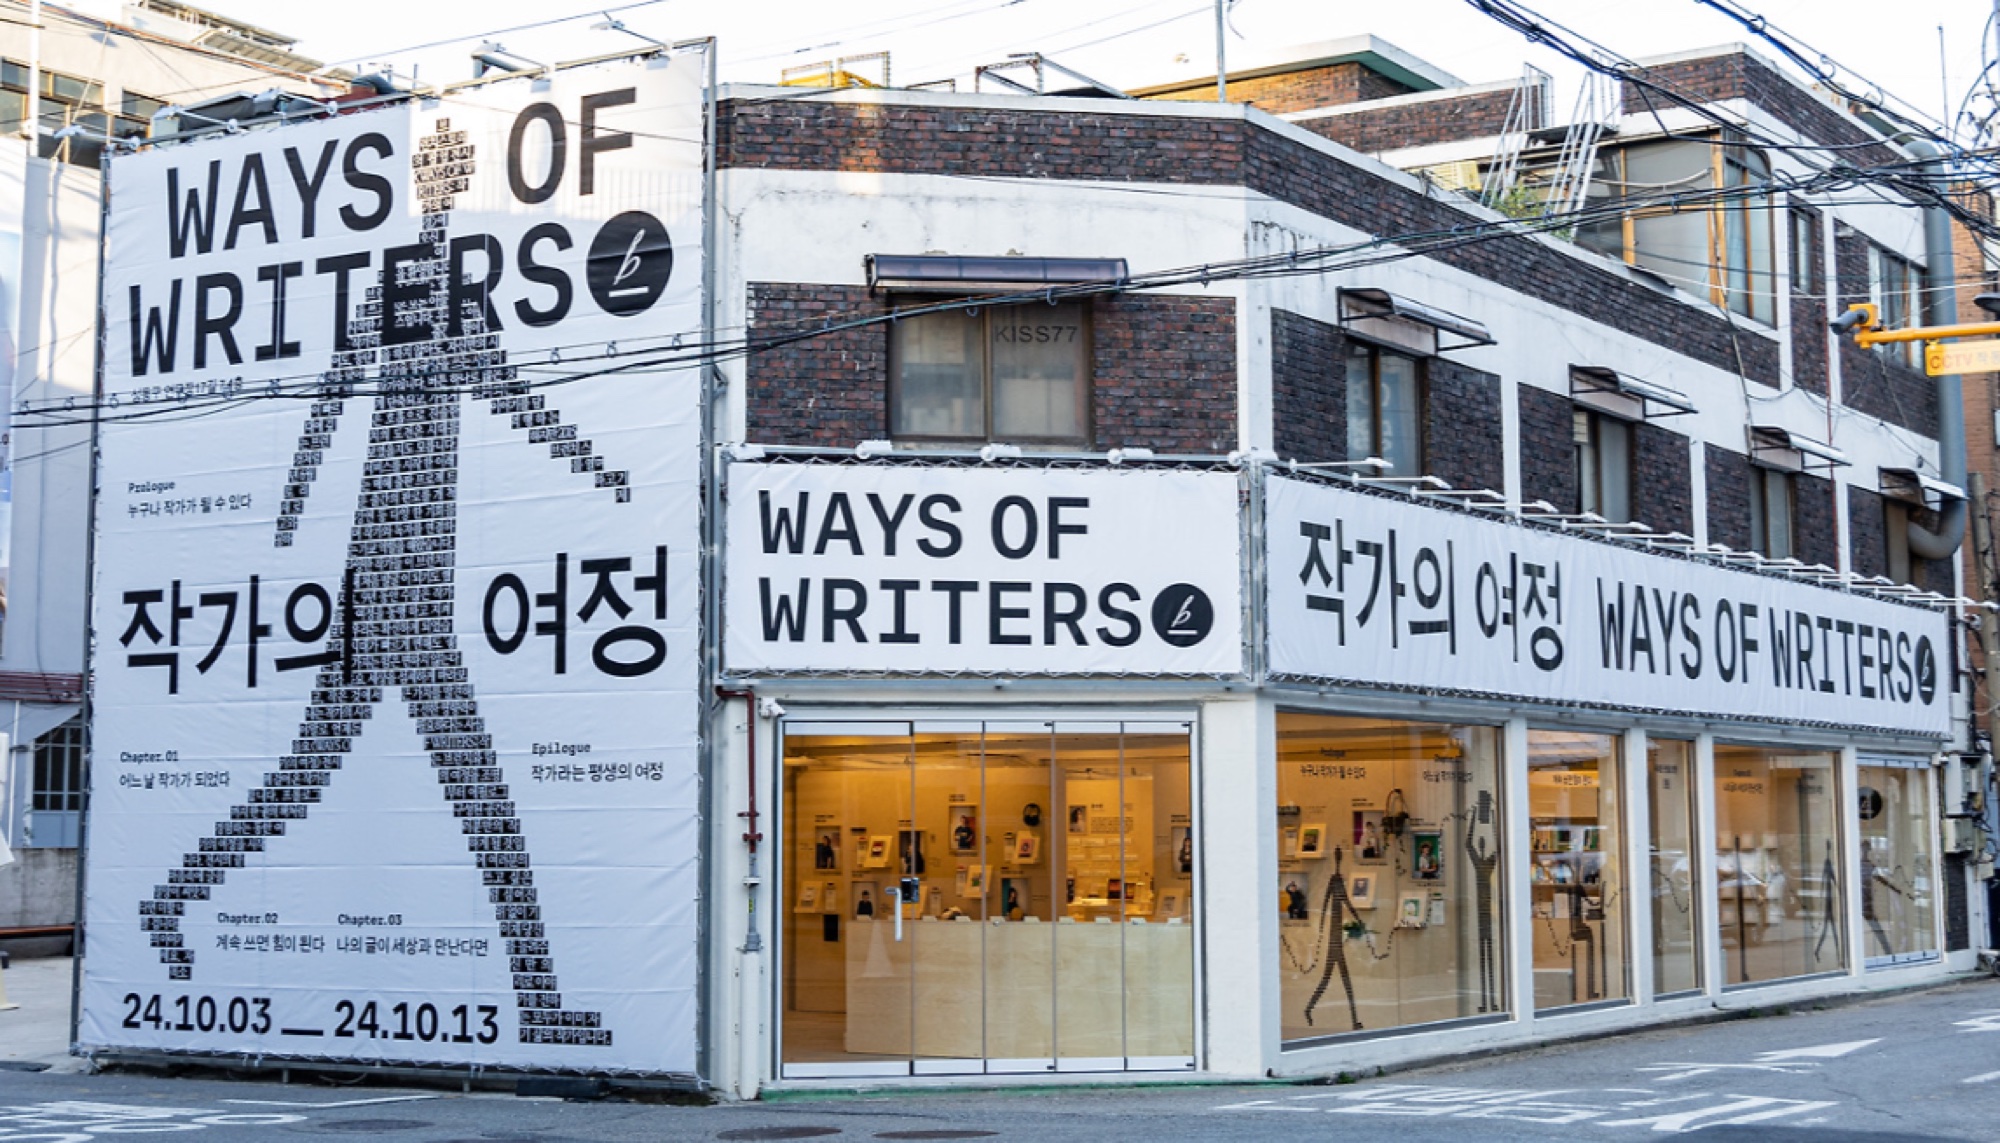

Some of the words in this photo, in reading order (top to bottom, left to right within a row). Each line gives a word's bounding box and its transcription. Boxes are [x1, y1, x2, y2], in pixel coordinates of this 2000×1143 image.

[167, 131, 394, 259] WAYS
[507, 87, 637, 204] OF
[129, 222, 574, 377] WRITERS
[994, 325, 1078, 343] KISS77
[1930, 353, 1972, 370] CCTV
[128, 481, 176, 494] Prologue
[127, 500, 161, 518] 누구나
[163, 497, 197, 515] 작가가
[199, 496, 212, 514] 될
[214, 495, 226, 512] 수
[228, 492, 252, 511] 있다
[758, 489, 964, 559] WAYS
[990, 494, 1090, 560] OF
[119, 568, 354, 694] 작가의
[483, 546, 668, 678] 여정
[758, 577, 1143, 647] WRITERS
[1299, 517, 1456, 655] 작가의
[1476, 552, 1565, 672] 여정
[1596, 576, 1701, 681] WAYS
[1714, 598, 1759, 684] OF
[1768, 606, 1914, 704] WRITERS
[120, 750, 178, 764] Chapter.01
[531, 741, 592, 757] Epilogue
[158, 771, 192, 788] 작가가
[194, 770, 230, 788] 되었다
[531, 763, 586, 783] 작가라는
[587, 762, 632, 782] 평생의
[634, 761, 664, 781] 여정
[217, 912, 278, 926] Chapter.02
[337, 913, 402, 927] Chapter.03
[216, 934, 241, 951] 계속
[243, 934, 269, 952] 쓰면
[272, 934, 296, 952] 힘이
[299, 934, 325, 953] 된다
[336, 936, 362, 953] 나의
[364, 936, 389, 954] 글이
[391, 936, 431, 955] 세상과
[434, 937, 488, 957] 만난다면
[122, 992, 272, 1034] 24.10.03
[334, 999, 499, 1044] 24.10.13
